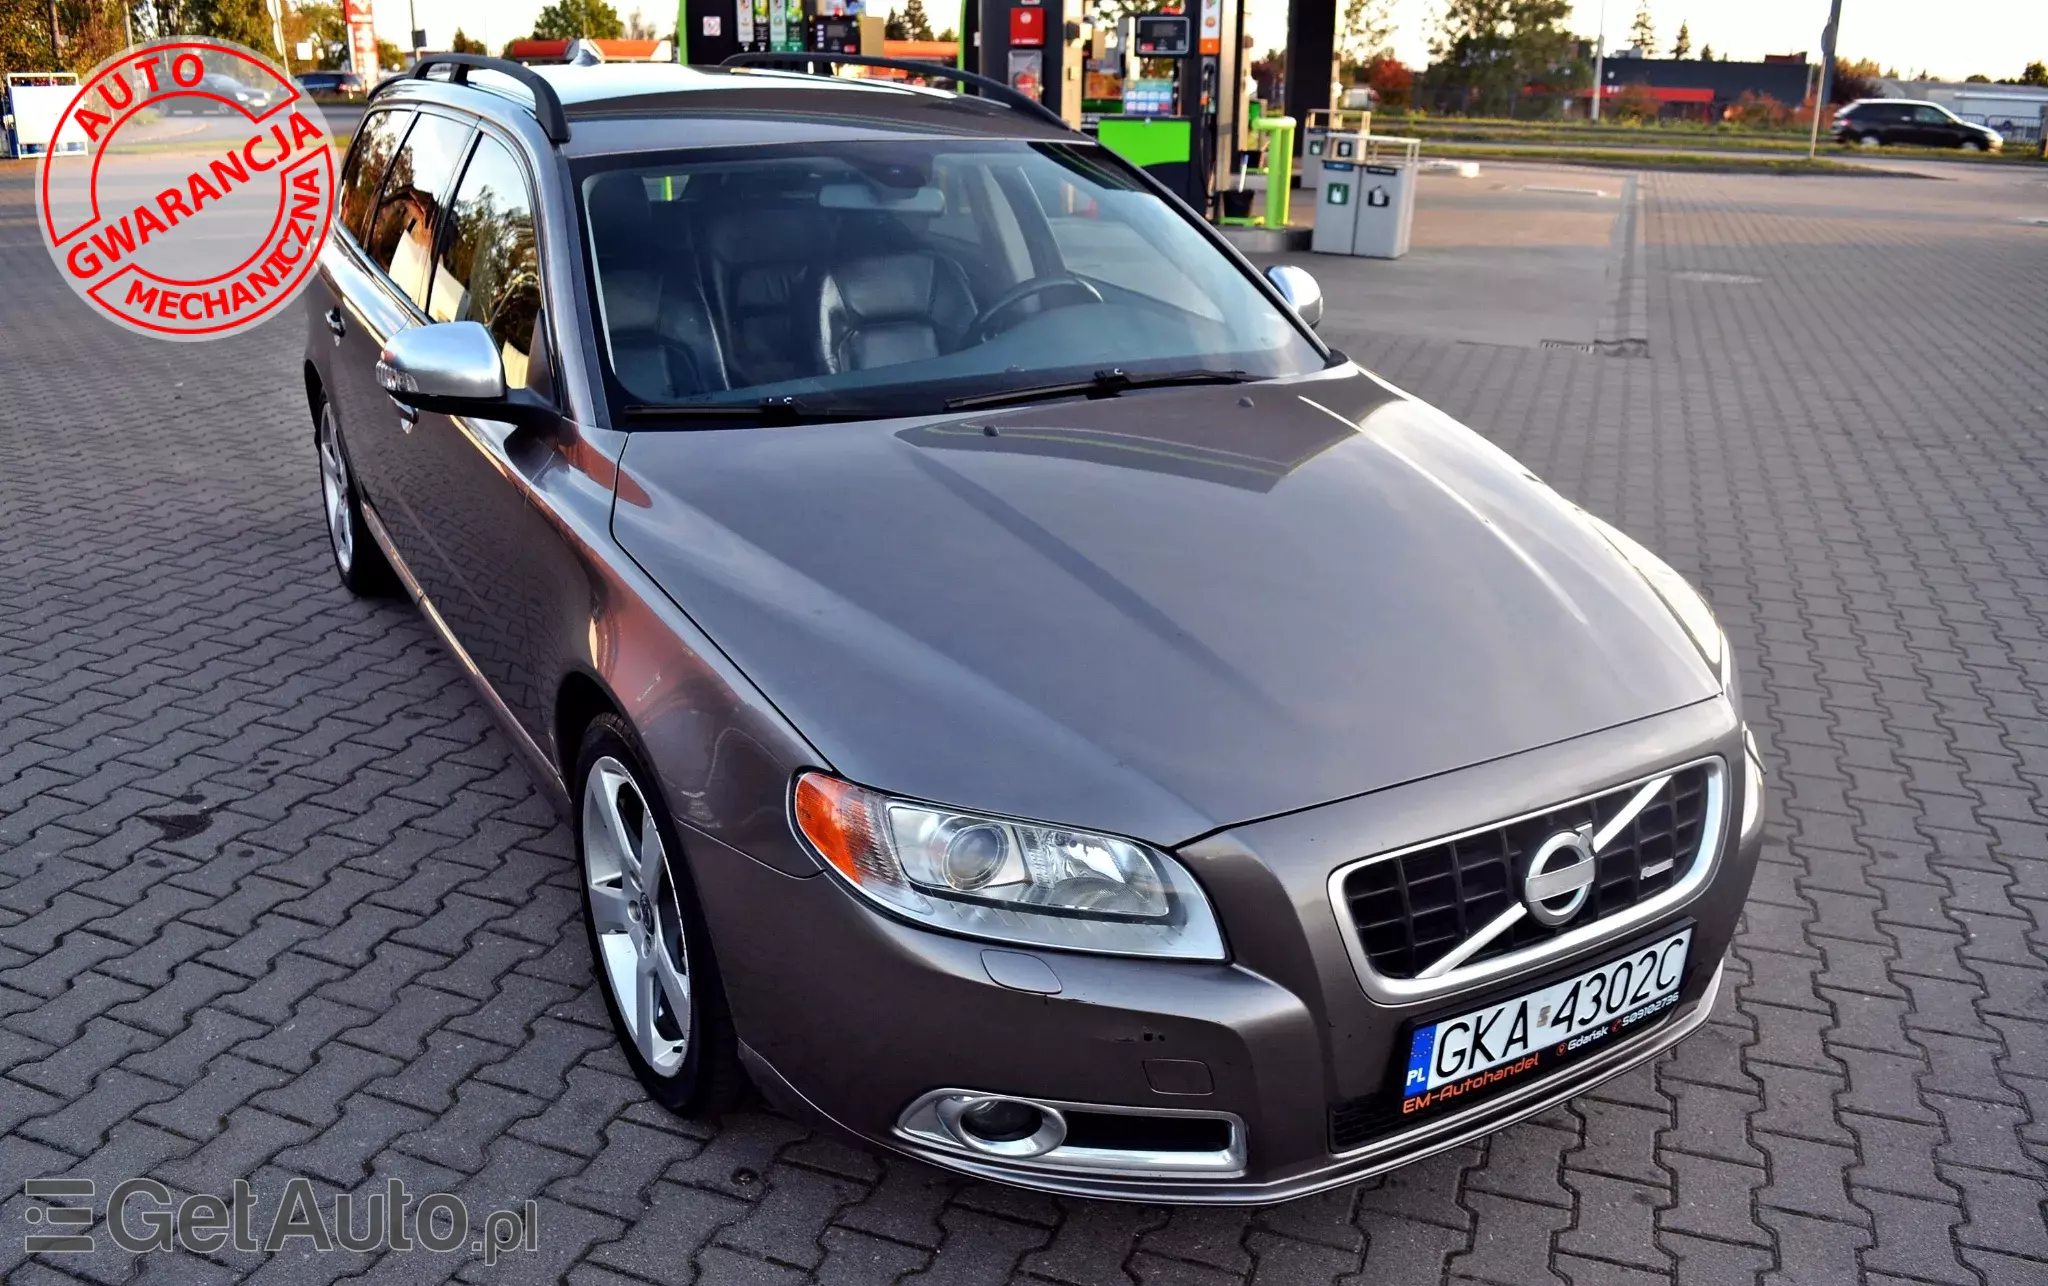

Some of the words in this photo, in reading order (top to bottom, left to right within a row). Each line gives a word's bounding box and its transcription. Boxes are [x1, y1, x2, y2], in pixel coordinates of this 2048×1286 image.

[1435, 1000, 1529, 1078] GKA
[1551, 938, 1684, 1034] 4302C
[1402, 1052, 1540, 1114] EM-Autohandel
[1406, 1067, 1426, 1087] PL
